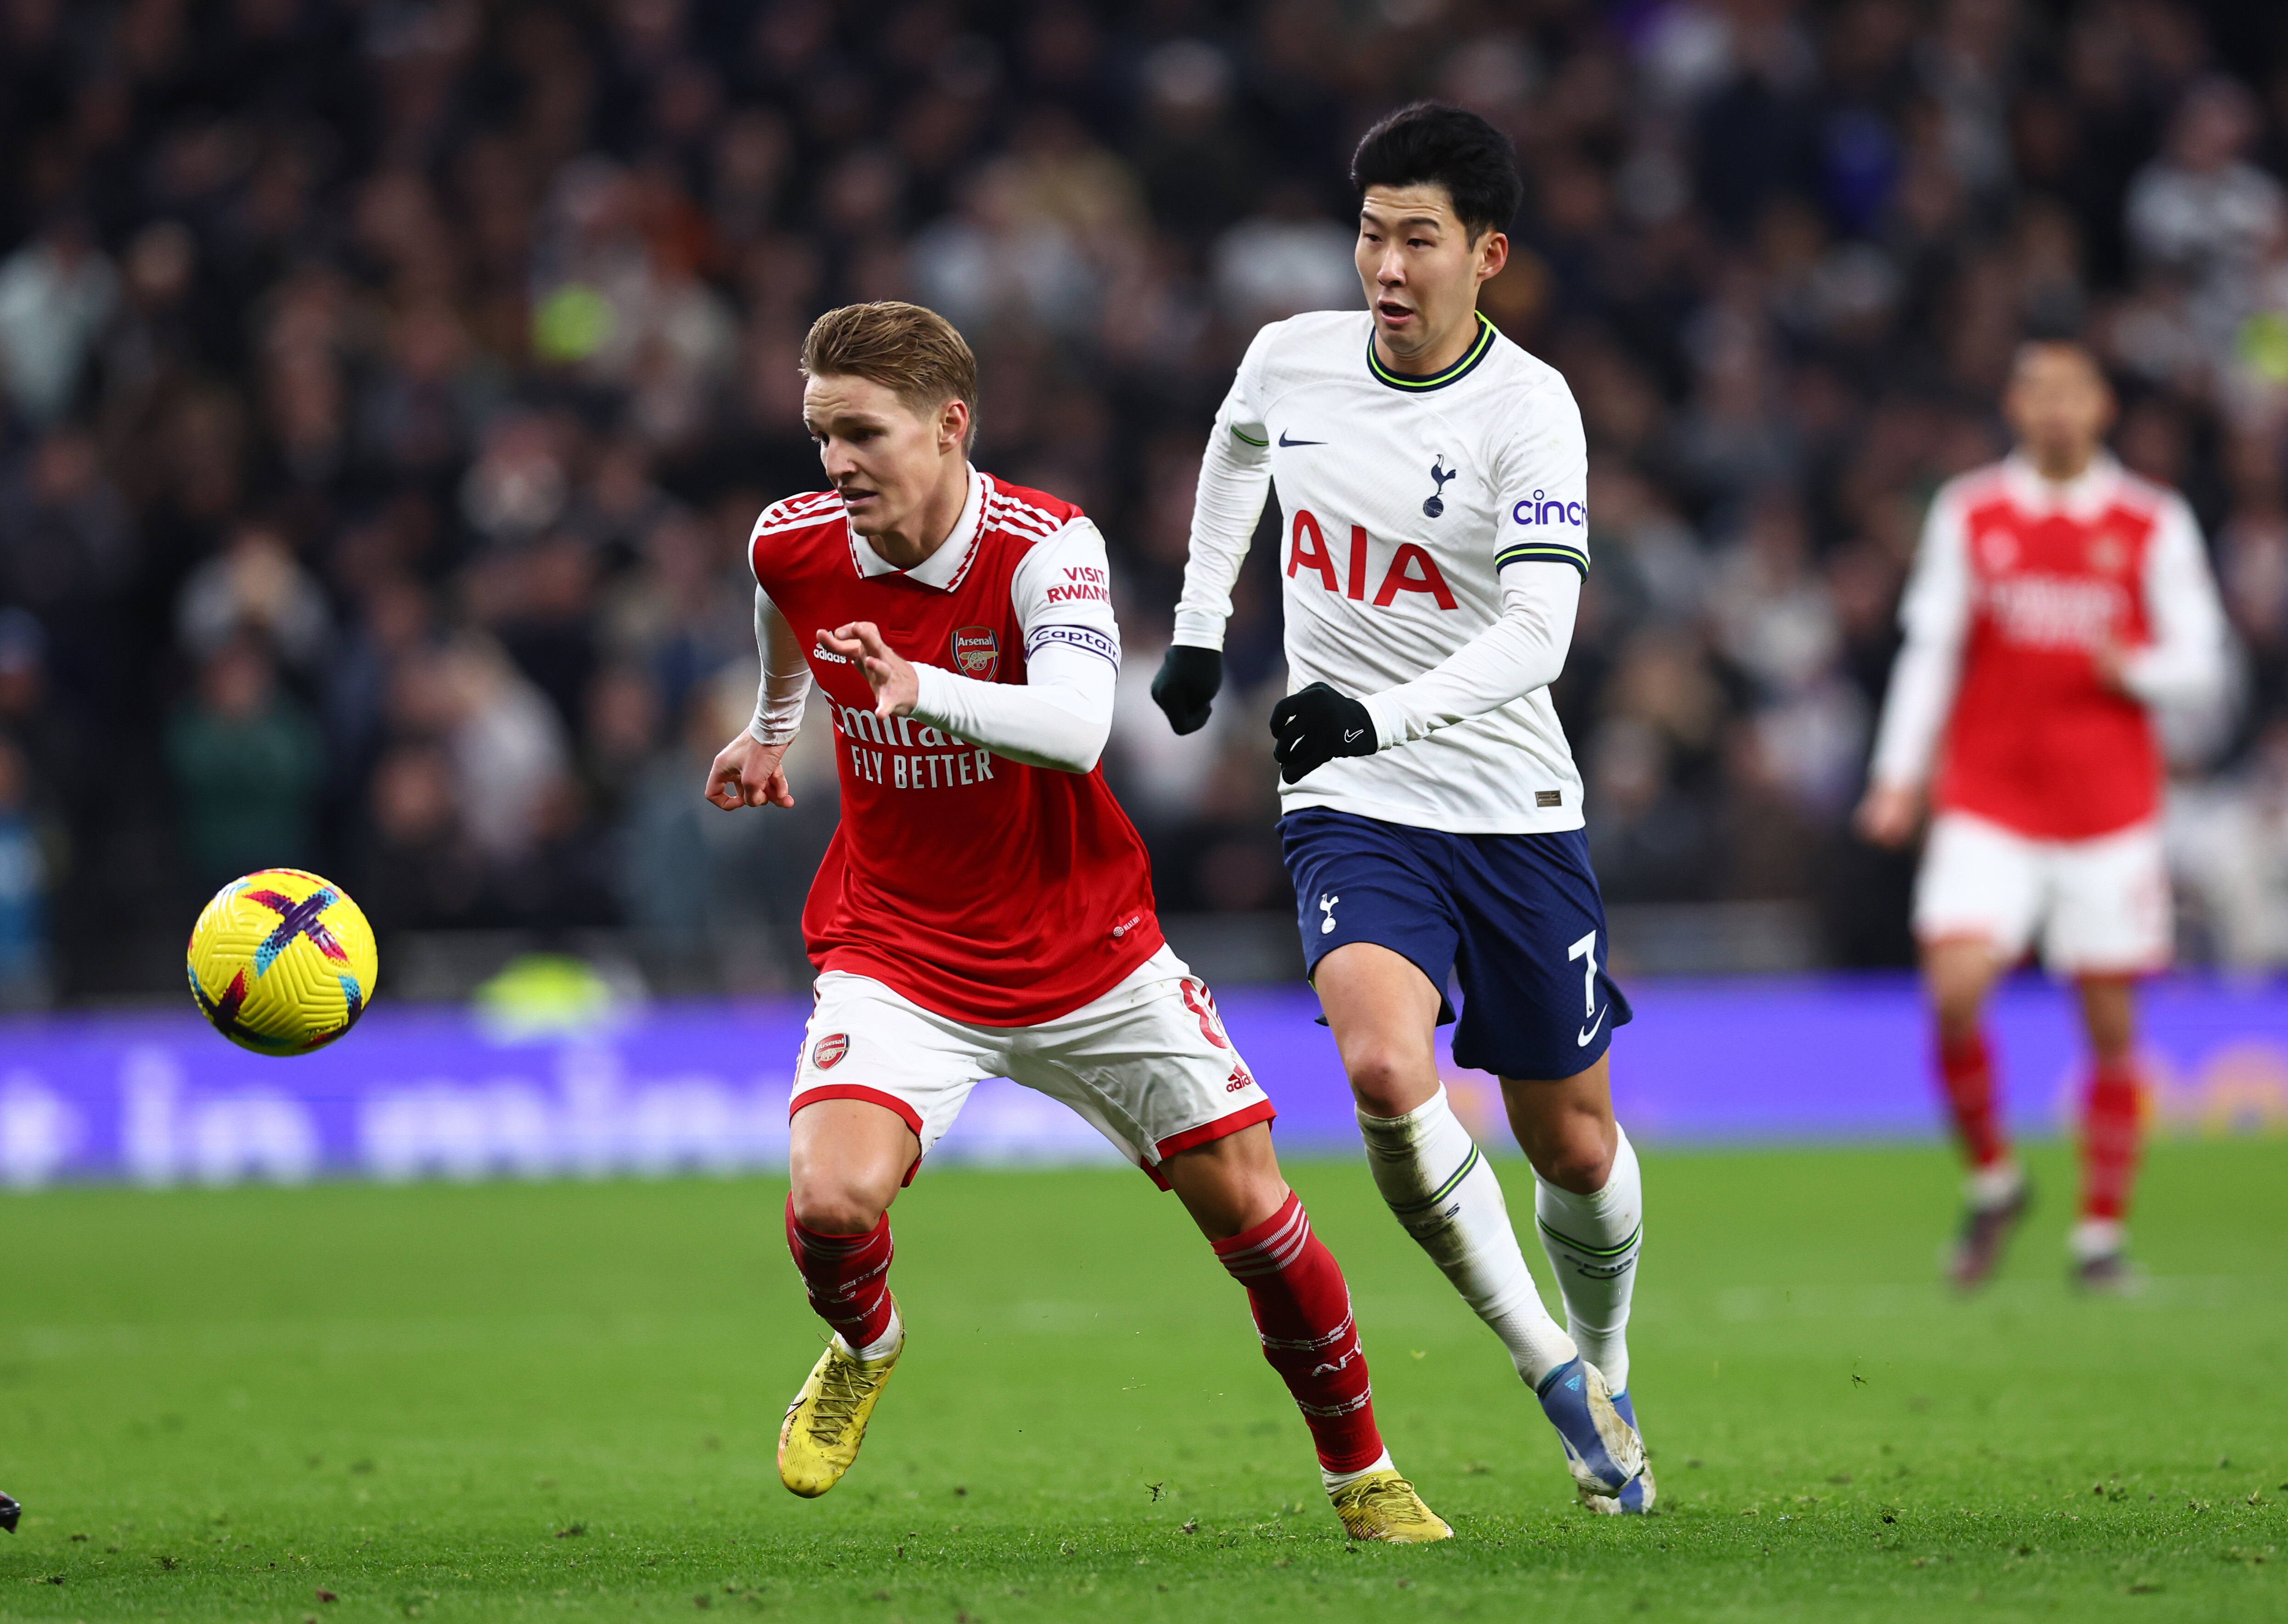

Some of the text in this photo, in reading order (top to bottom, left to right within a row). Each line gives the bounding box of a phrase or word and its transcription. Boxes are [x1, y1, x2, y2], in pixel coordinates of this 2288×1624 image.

[1513, 489, 1589, 529] cinch
[1287, 510, 1459, 610] AIA
[1063, 567, 1105, 585] VISIT
[958, 636, 992, 647] Arsenal
[1036, 631, 1119, 664] Captain
[813, 648, 847, 664] adidas
[851, 744, 994, 789] FLY BETTER
[1567, 929, 1598, 1019] 7
[817, 1038, 845, 1050] Arsenal
[1226, 1073, 1255, 1093] adid
